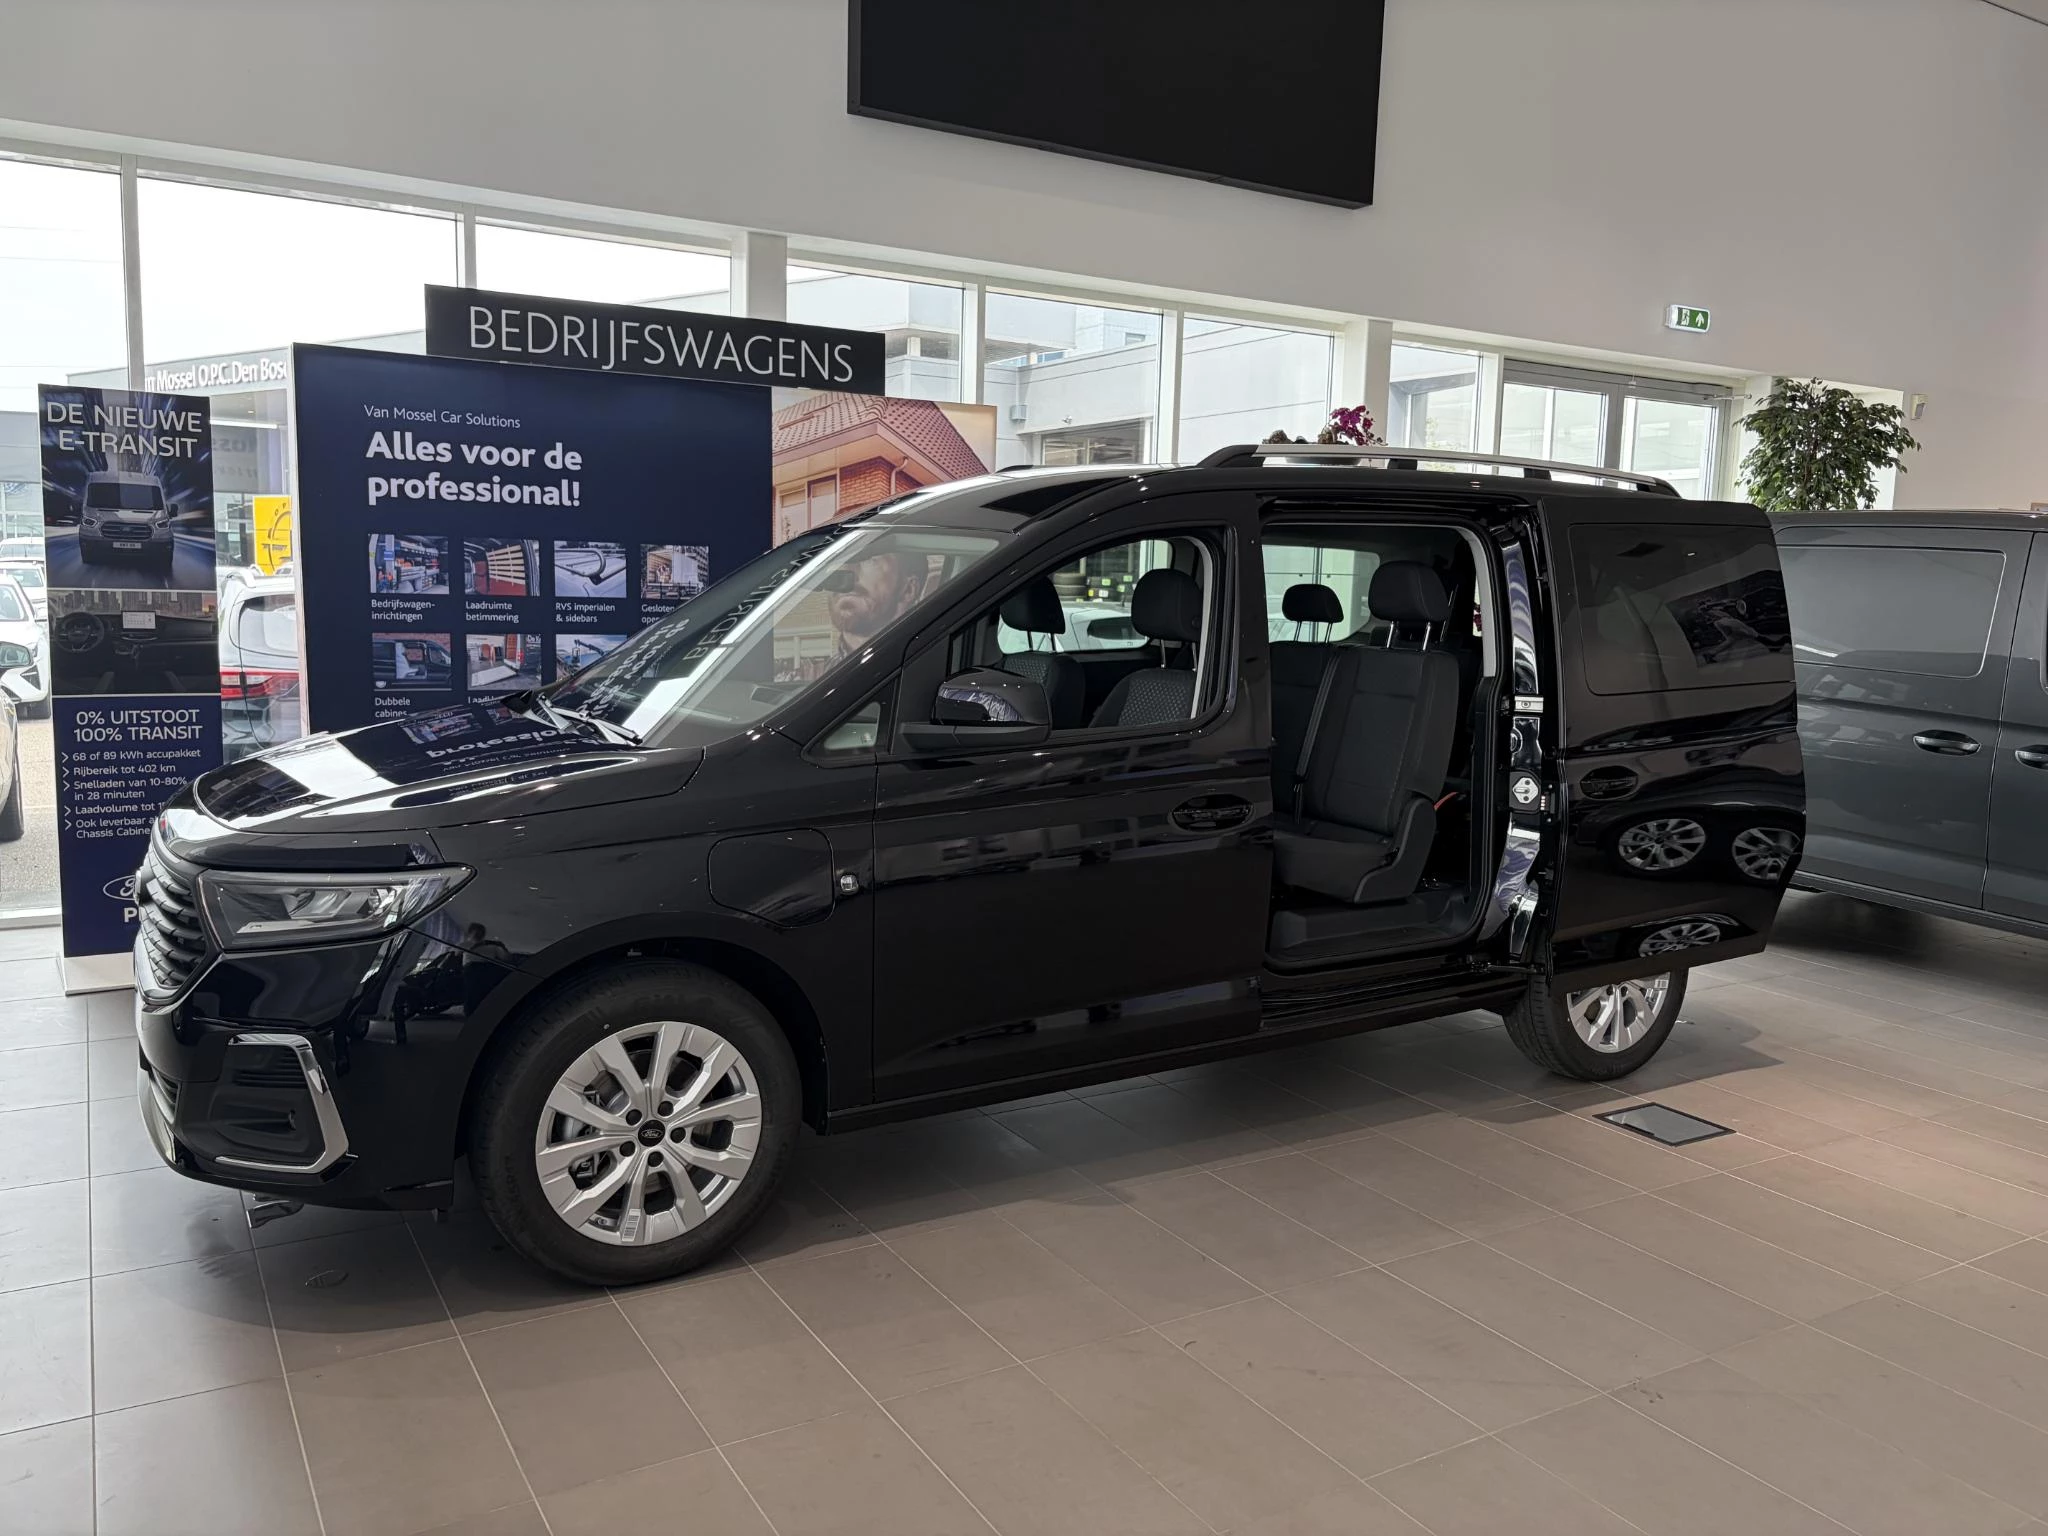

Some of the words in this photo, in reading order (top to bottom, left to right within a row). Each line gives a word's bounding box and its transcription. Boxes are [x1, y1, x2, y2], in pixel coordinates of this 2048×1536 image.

[469, 305, 853, 383] BEDRIJFSWAGENS
[157, 365, 196, 391] Mossel
[47, 401, 83, 424] DE
[95, 406, 202, 432] NIEUWE
[364, 404, 389, 419] Van
[394, 407, 437, 422] Mossel
[440, 410, 462, 424] Car
[466, 412, 521, 429] Solutions
[59, 430, 197, 458] E-TRANSIT
[365, 431, 453, 463] Alles
[460, 444, 536, 468] voor
[544, 442, 583, 471] de
[368, 472, 580, 507] professional!
[371, 599, 436, 611] Bedrijfswagen-
[466, 601, 512, 611] Laadruimte
[556, 602, 572, 612] RVS
[574, 602, 616, 613] imperialen
[371, 611, 423, 623] inrichtingen
[466, 612, 519, 624] betimmering
[555, 614, 564, 622] &
[565, 614, 598, 623] sidebars
[375, 697, 411, 706] Dubbele
[76, 711, 105, 725] 0%
[110, 709, 200, 724] UITSTOOT
[73, 727, 123, 742] 100%
[128, 725, 203, 741] TRANSIT
[73, 752, 87, 761] 68
[90, 751, 101, 760] of
[103, 751, 117, 760] 89
[120, 750, 143, 759] kWh
[146, 749, 201, 760] accupakket
[73, 766, 118, 777] Rijbereik
[121, 765, 135, 774] tot
[138, 765, 157, 774] 402
[160, 764, 176, 773] km
[74, 779, 125, 790] Snelladen
[128, 779, 147, 787] van
[149, 777, 187, 787] 10-80%
[75, 793, 84, 801] in
[87, 791, 101, 800] 28
[103, 790, 145, 800] minuten
[75, 804, 138, 815] Laadvolume
[141, 802, 156, 811] tot
[76, 819, 97, 829] Ook
[100, 817, 149, 828] leverbaar
[76, 828, 114, 839] Chassis
[116, 826, 151, 836] Cabine
